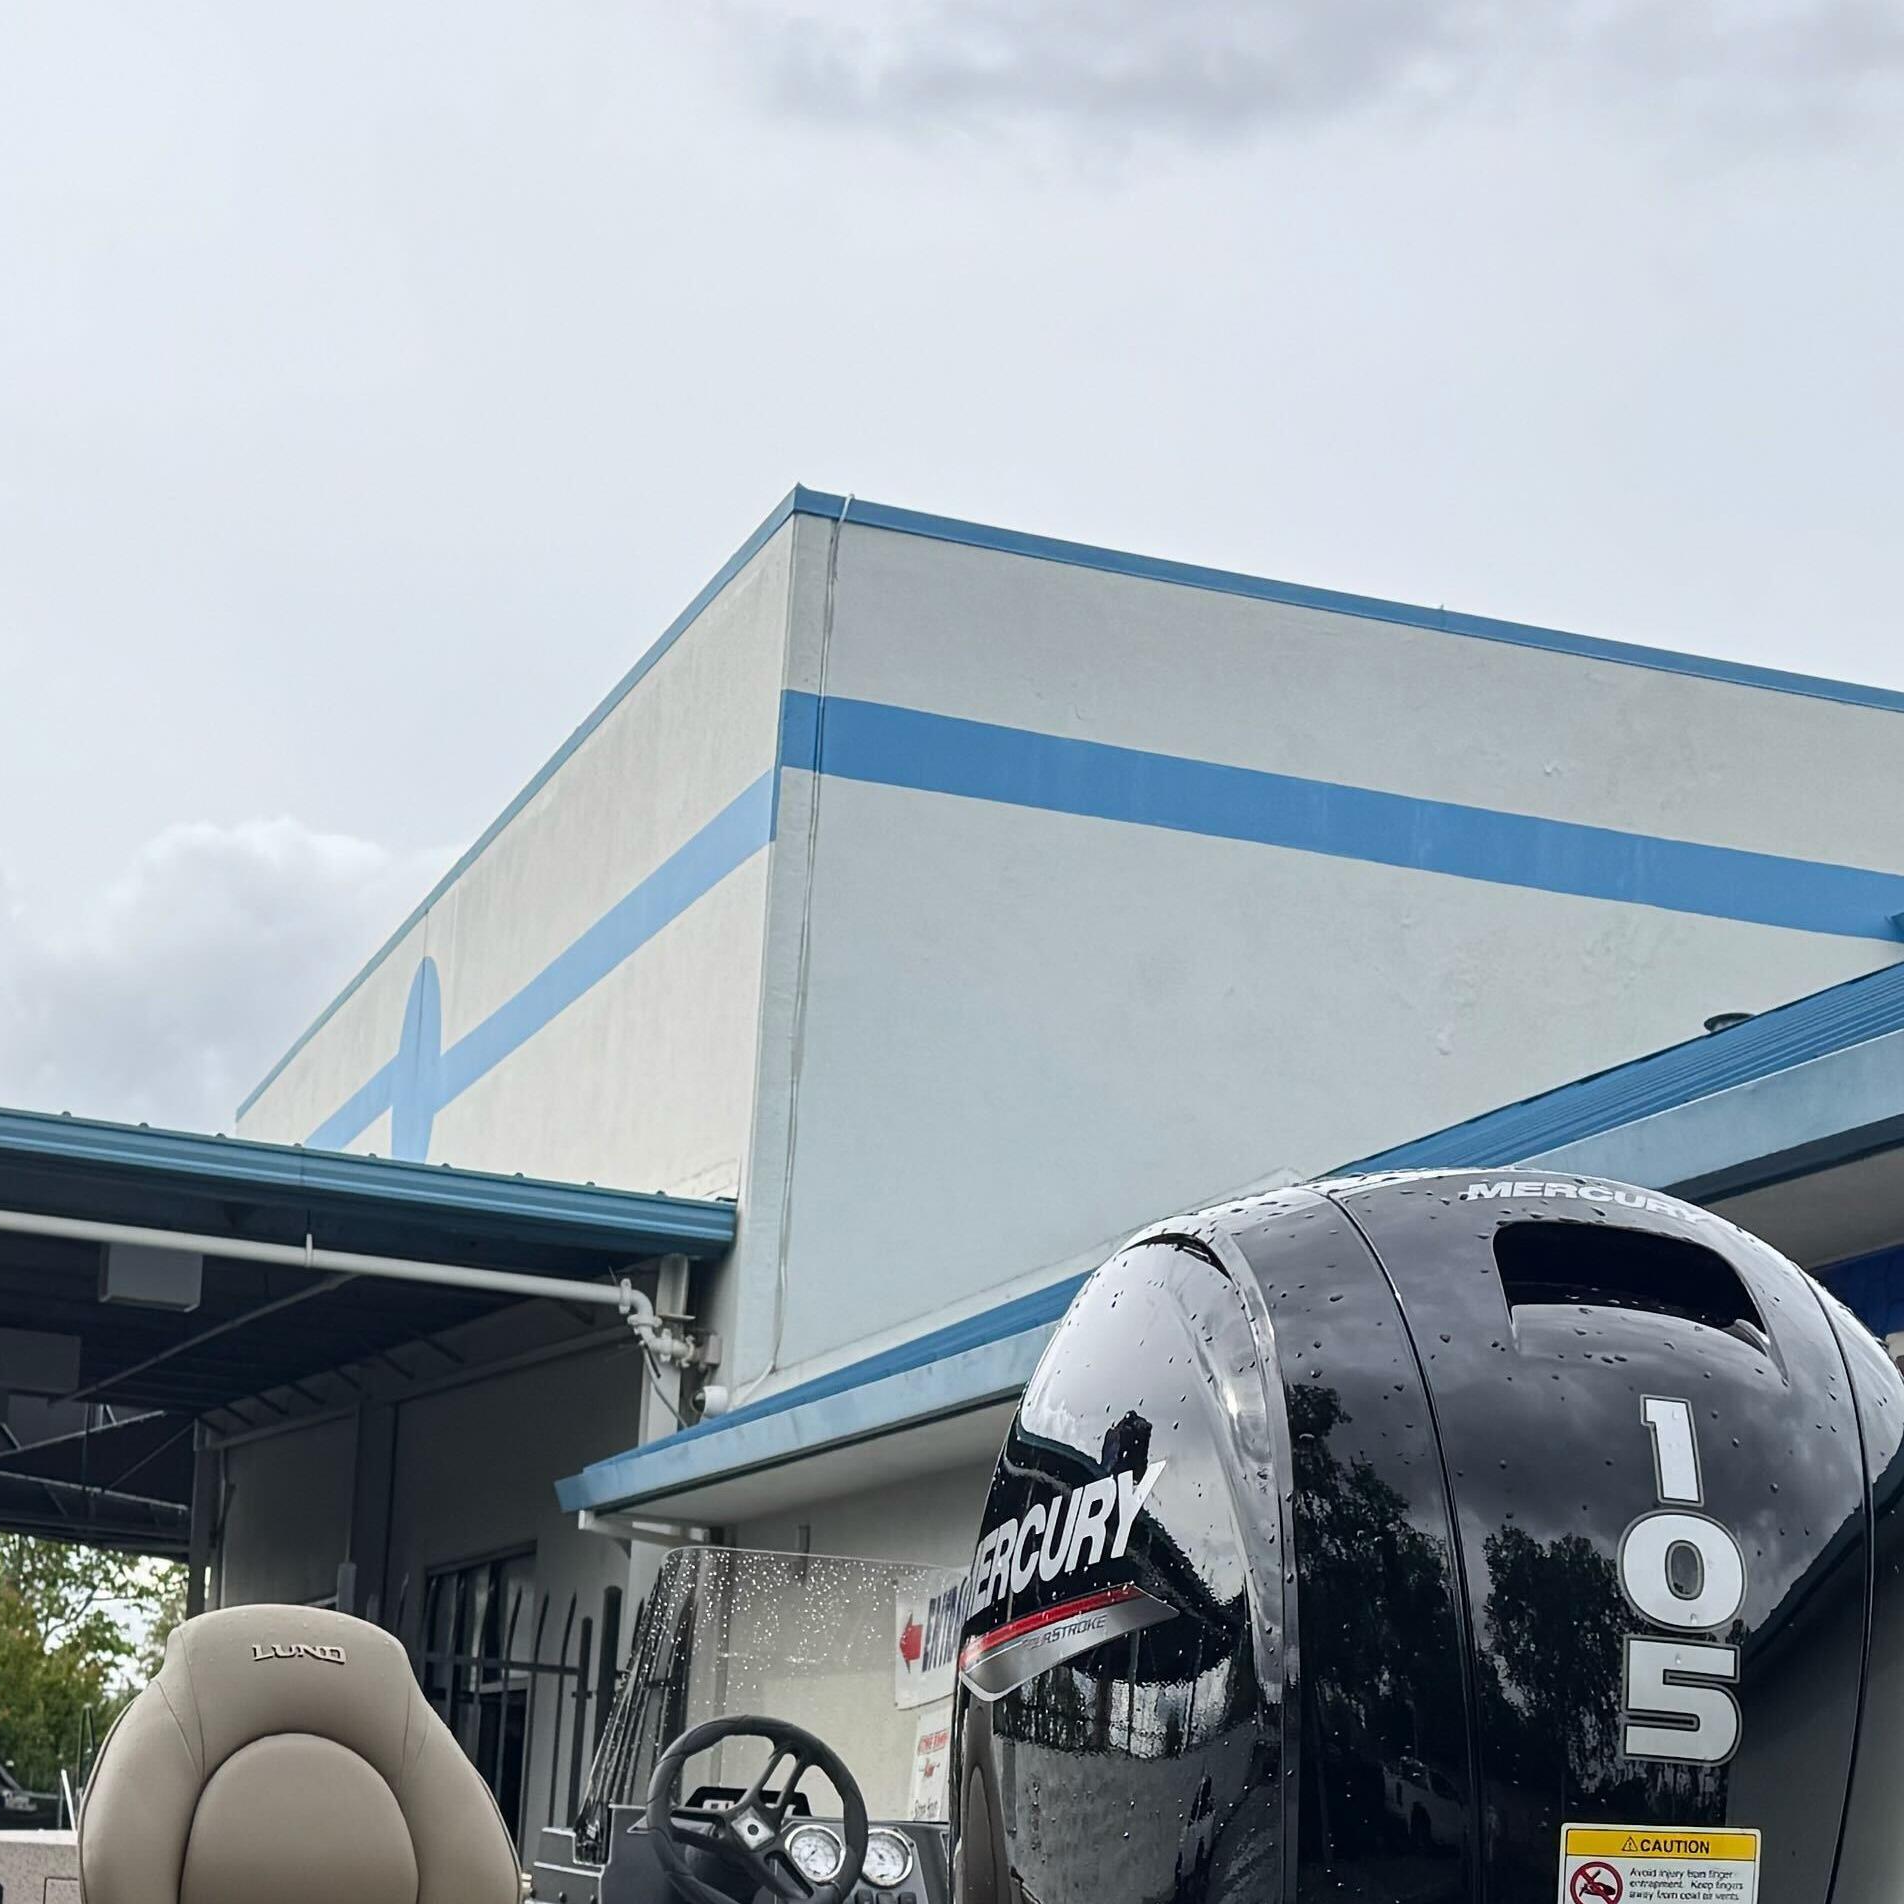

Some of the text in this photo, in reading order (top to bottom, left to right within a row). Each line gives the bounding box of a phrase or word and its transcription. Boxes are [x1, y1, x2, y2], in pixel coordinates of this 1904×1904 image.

[1458, 1180, 1709, 1222] MERCURY
[968, 1460, 1166, 1620] ERCURY
[1616, 1394, 1748, 1767] 105
[251, 1643, 346, 1665] LUND
[1639, 1839, 1710, 1855] CAUTION
[1629, 1867, 1657, 1878] Avoid
[1659, 1868, 1684, 1880] injury
[1690, 1880, 1713, 1892] Keep
